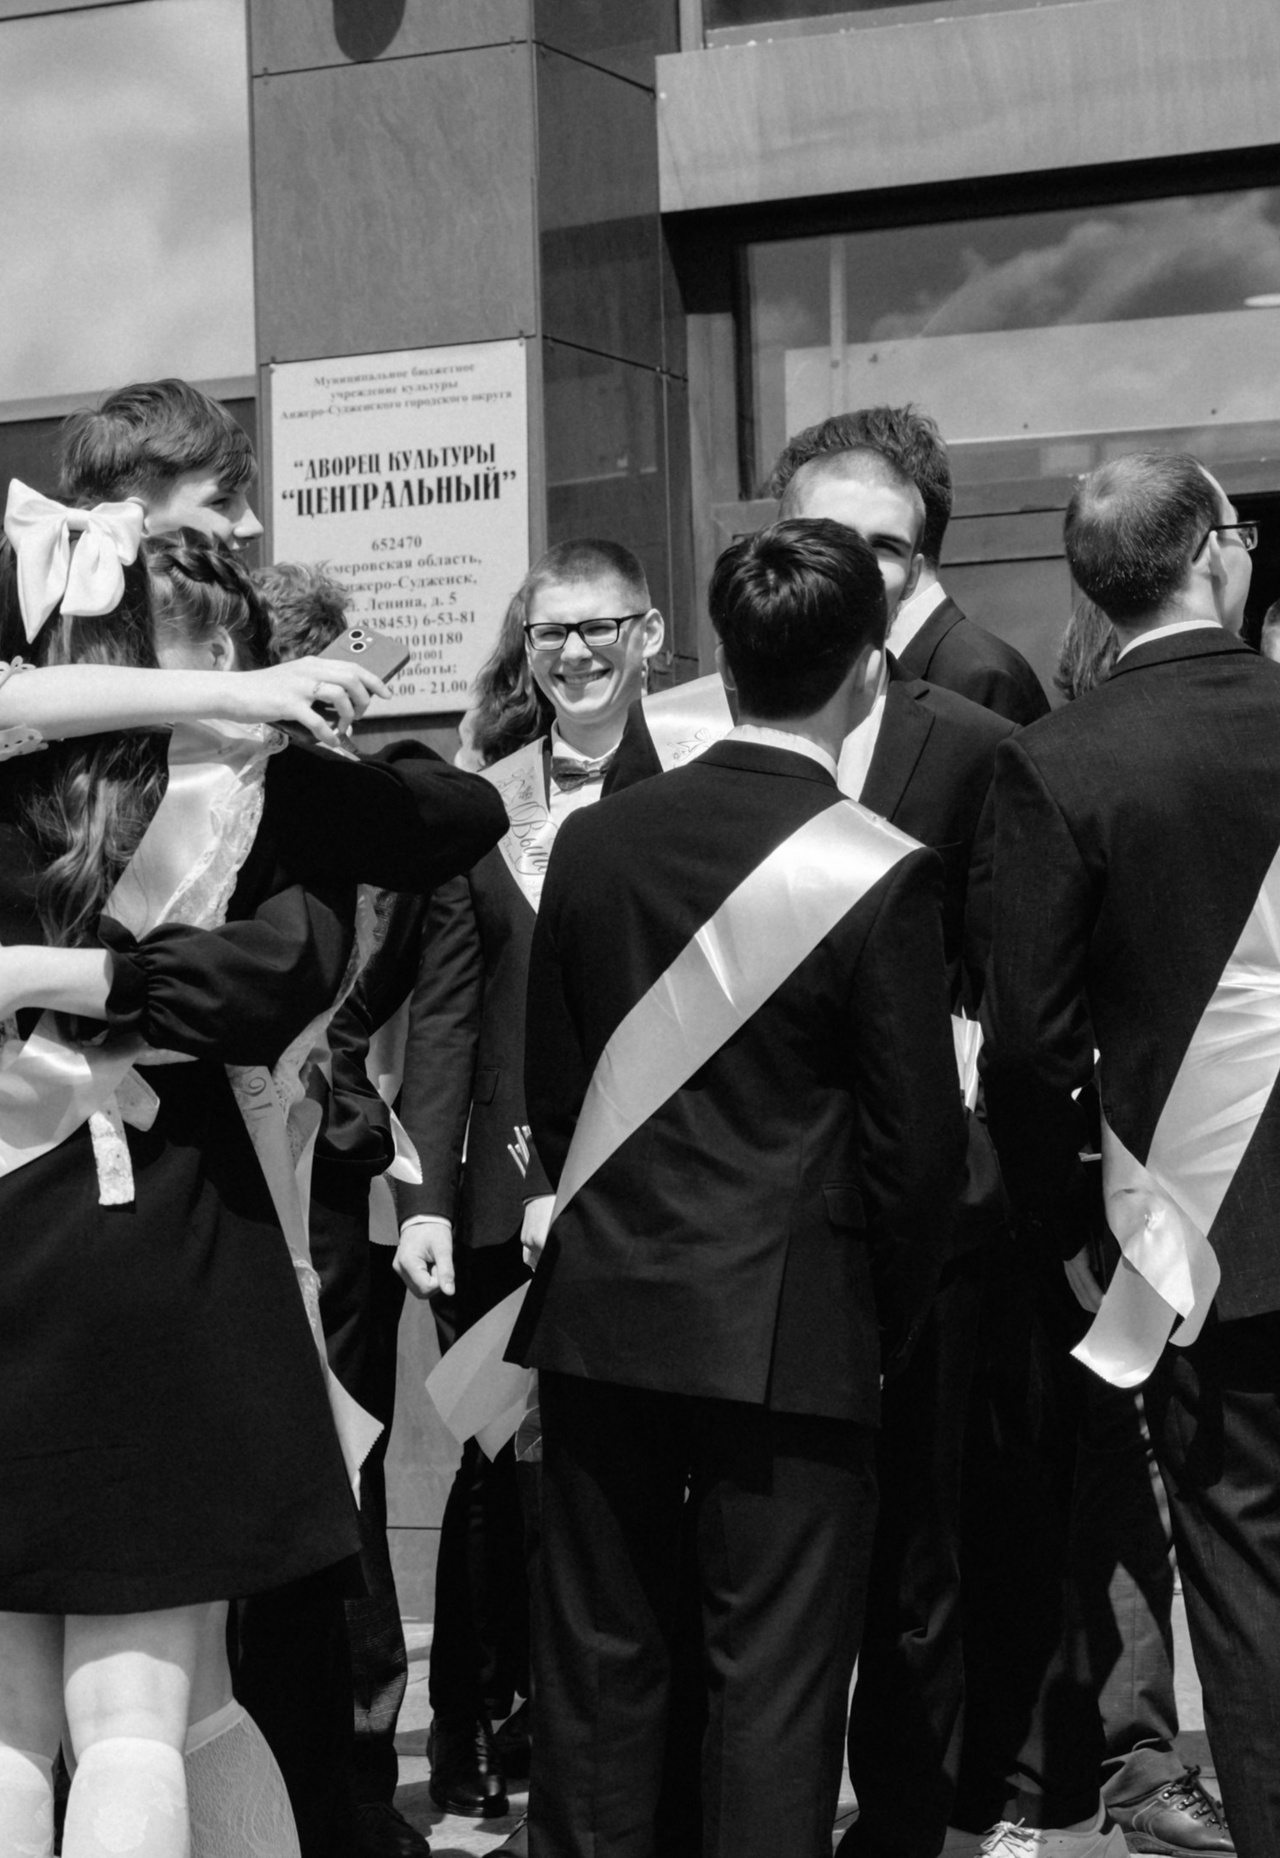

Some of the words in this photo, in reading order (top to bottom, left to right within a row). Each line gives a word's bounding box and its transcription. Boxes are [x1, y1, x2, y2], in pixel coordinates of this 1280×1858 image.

[313, 369, 408, 388] Муниципальное
[411, 363, 476, 378] бюджетное
[330, 385, 398, 402] учреждение
[401, 380, 458, 397] культуры
[280, 401, 402, 421] Анжеро-Судженского
[404, 395, 468, 410] городского
[471, 389, 512, 404] округа
[388, 443, 496, 472] КУЛЬТУРЫ
[371, 535, 423, 551] 652470
[324, 558, 413, 577] емеровская
[417, 552, 482, 569] область,
[364, 596, 427, 612] Ленина,
[448, 591, 457, 606] 5
[422, 610, 475, 627] 6-53-81
[430, 680, 468, 695] 21.00
